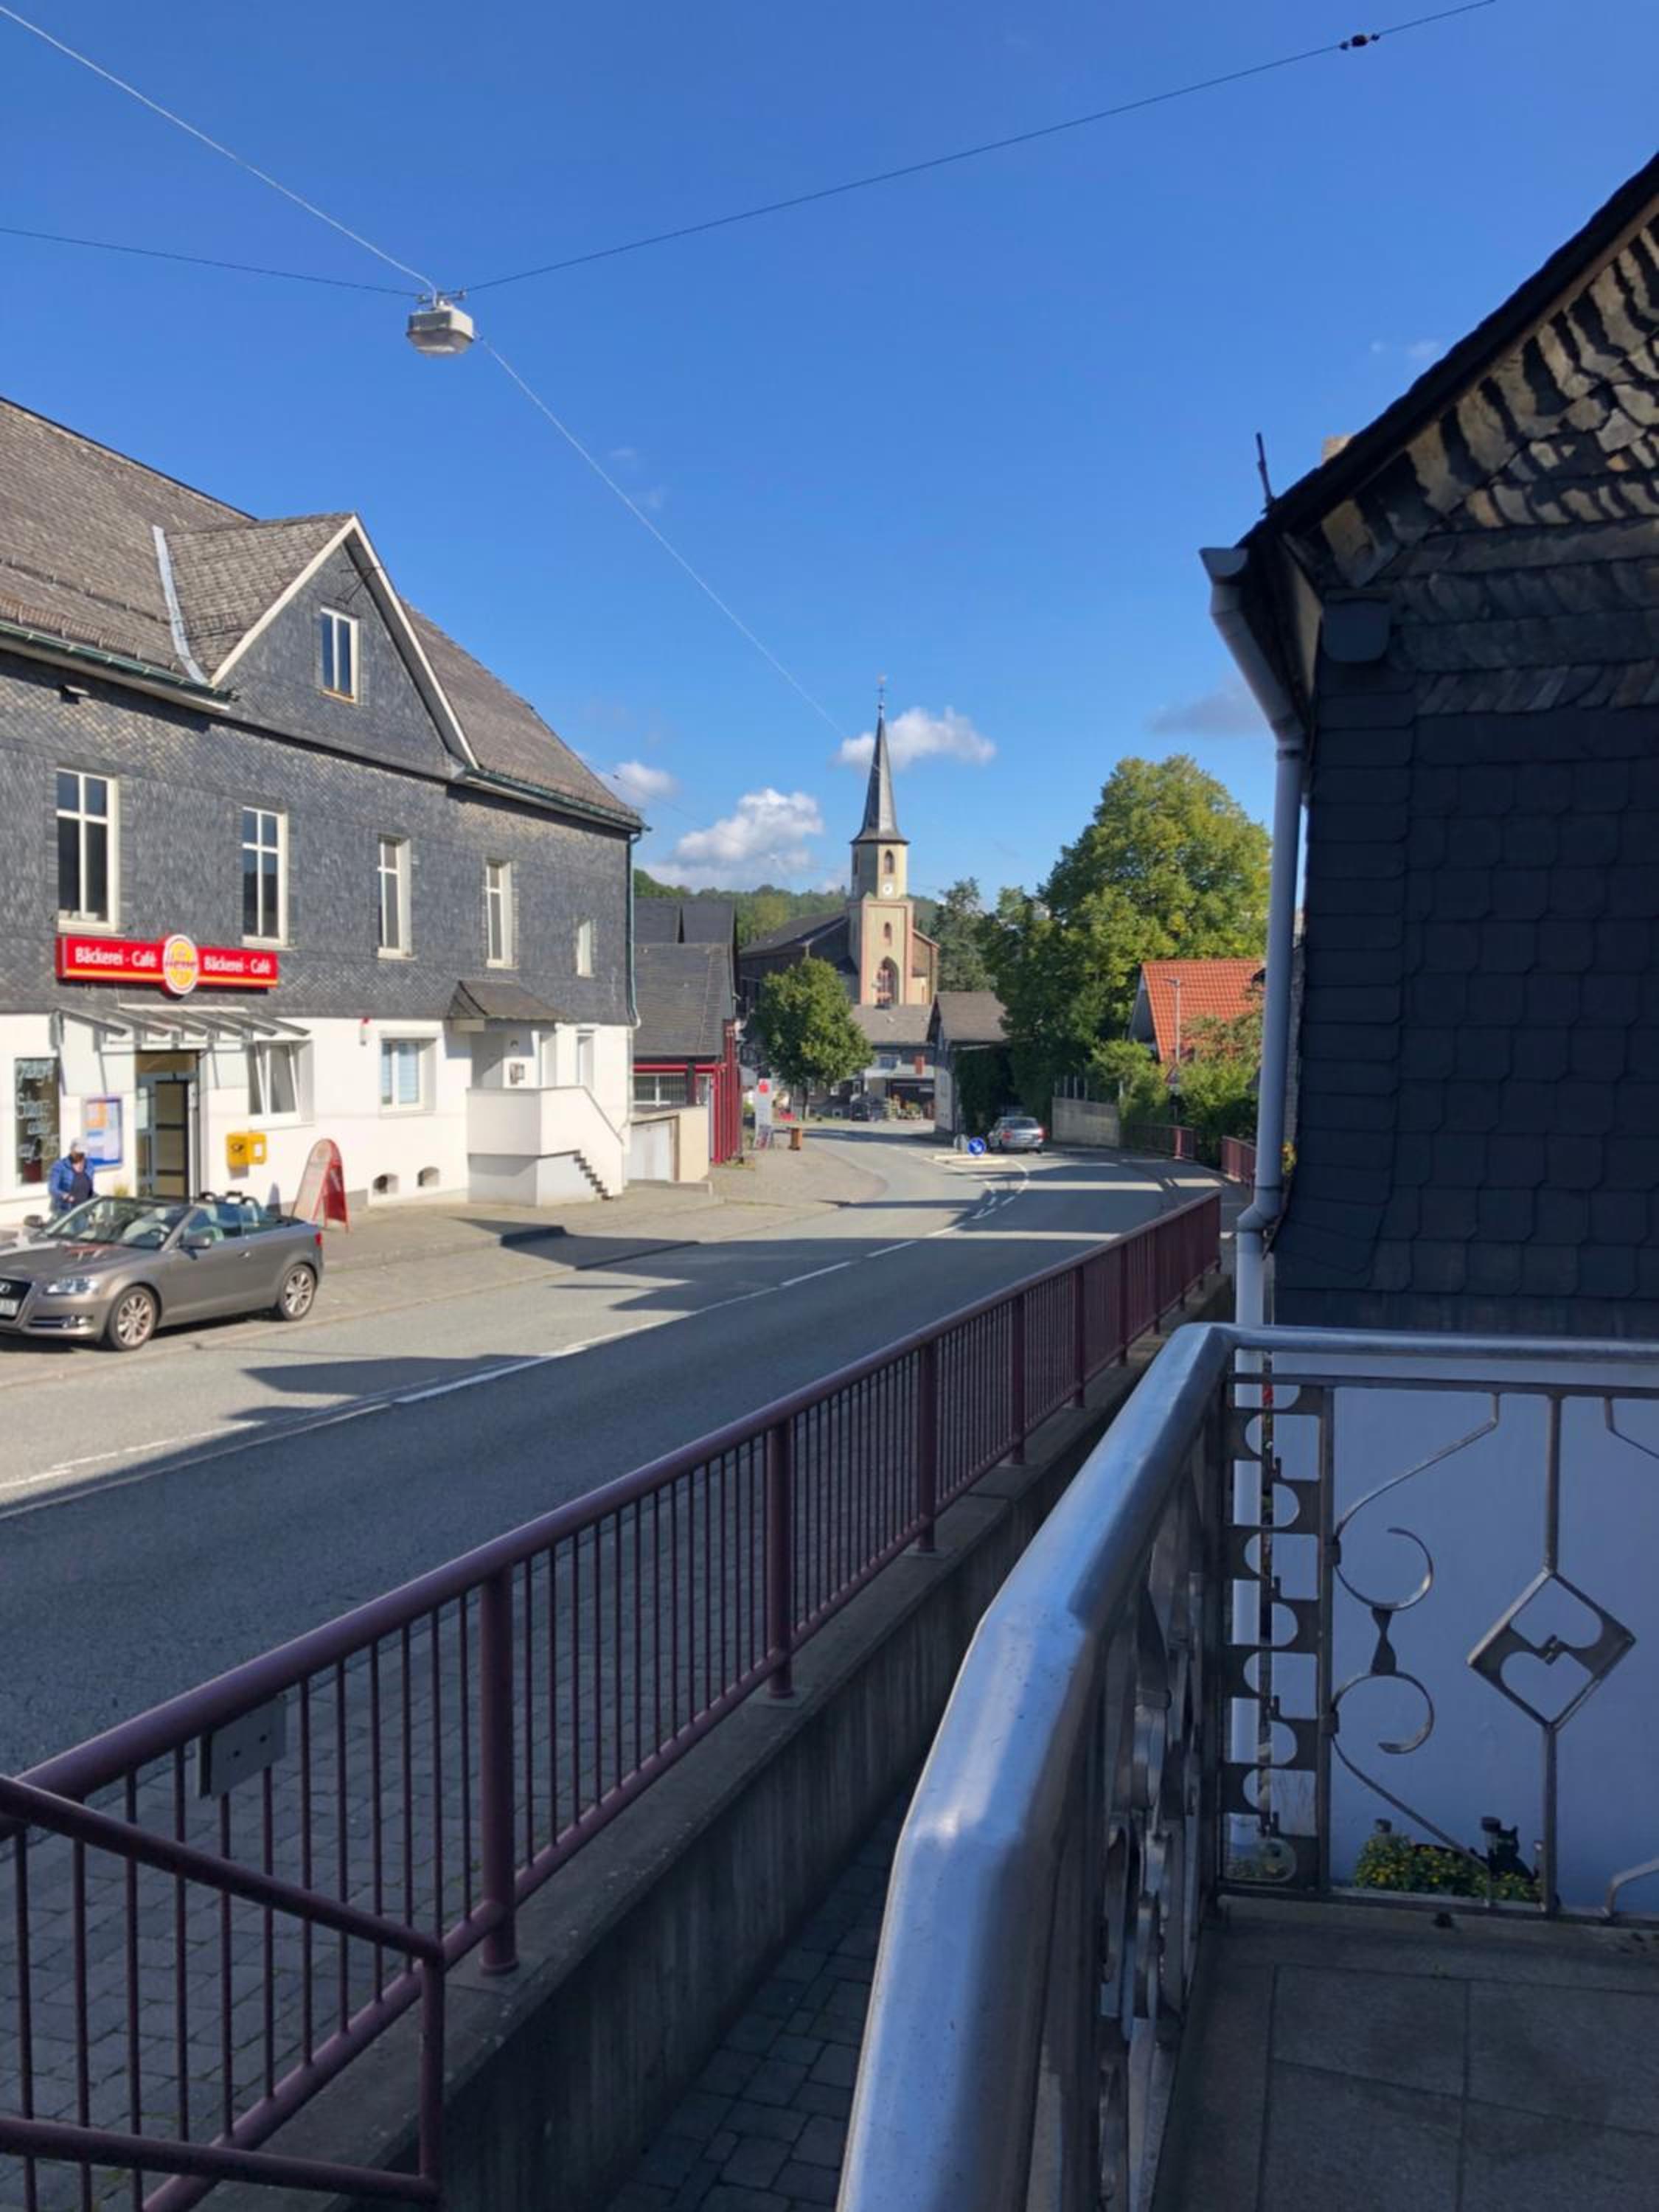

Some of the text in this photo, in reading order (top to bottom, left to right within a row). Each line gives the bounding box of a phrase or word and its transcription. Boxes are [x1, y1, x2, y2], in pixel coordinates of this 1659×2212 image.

[75, 947, 123, 966] Bäckerei
[131, 950, 156, 967] Café
[204, 956, 243, 973] Bäckerei
[251, 958, 271, 974] Café
